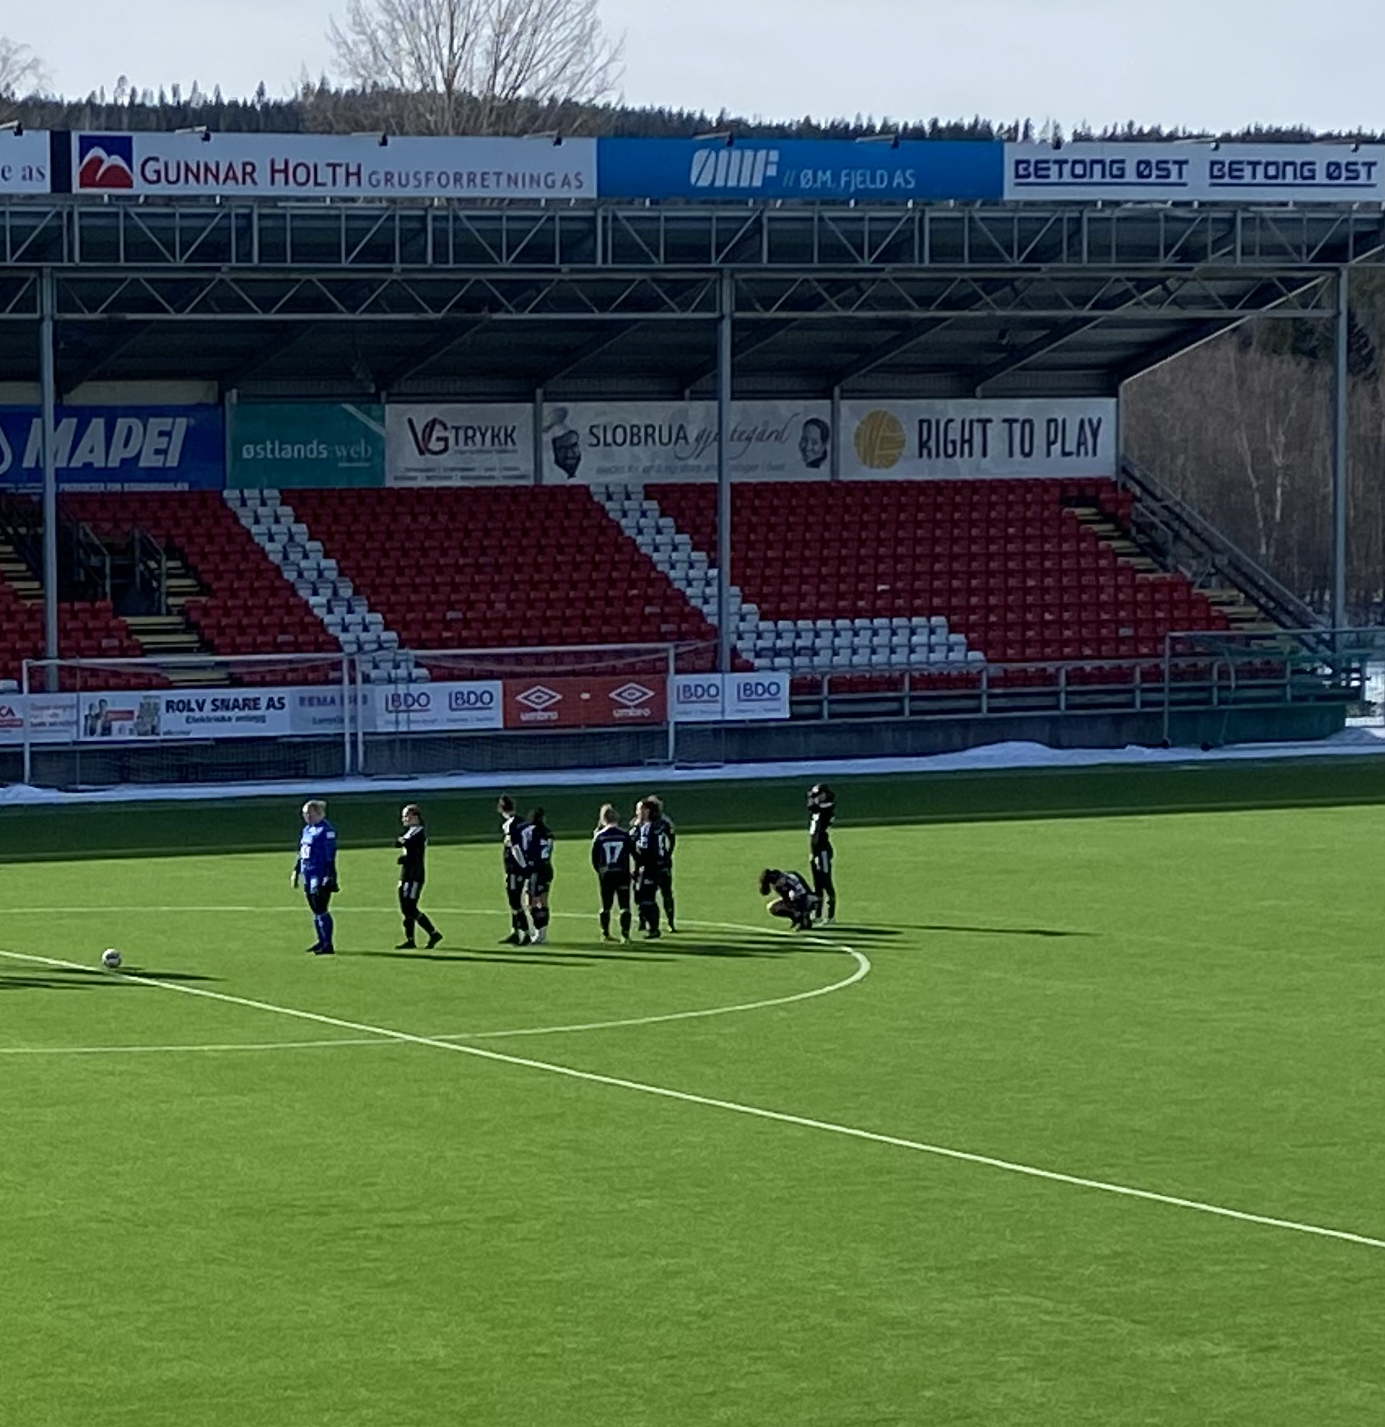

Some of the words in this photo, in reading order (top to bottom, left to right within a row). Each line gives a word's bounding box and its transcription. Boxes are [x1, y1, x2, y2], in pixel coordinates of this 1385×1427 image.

[20, 164, 46, 182] as
[140, 155, 257, 187] GUNNAR
[269, 157, 363, 189] HOLTH
[1014, 159, 1126, 180] BETONG
[1136, 159, 1190, 180] ØST
[1209, 160, 1317, 181] BETONG
[1325, 161, 1378, 181] ØST
[840, 168, 888, 192] FJELD
[893, 168, 916, 189] AS
[22, 416, 189, 469] MAPEI
[588, 424, 690, 448] SLOBRUA
[917, 417, 993, 460] RIGHT
[1001, 417, 1035, 459] TO
[1045, 416, 1103, 459] PLAY
[242, 439, 328, 459] østlands
[453, 690, 494, 706] BDO
[682, 683, 720, 699] BDO
[742, 681, 782, 697] BDO
[165, 698, 206, 714] ROLV
[211, 697, 262, 712] SNARE
[265, 696, 286, 711] AS
[299, 695, 336, 707] REMA
[390, 691, 431, 708] BDO
[603, 841, 624, 864] 17
